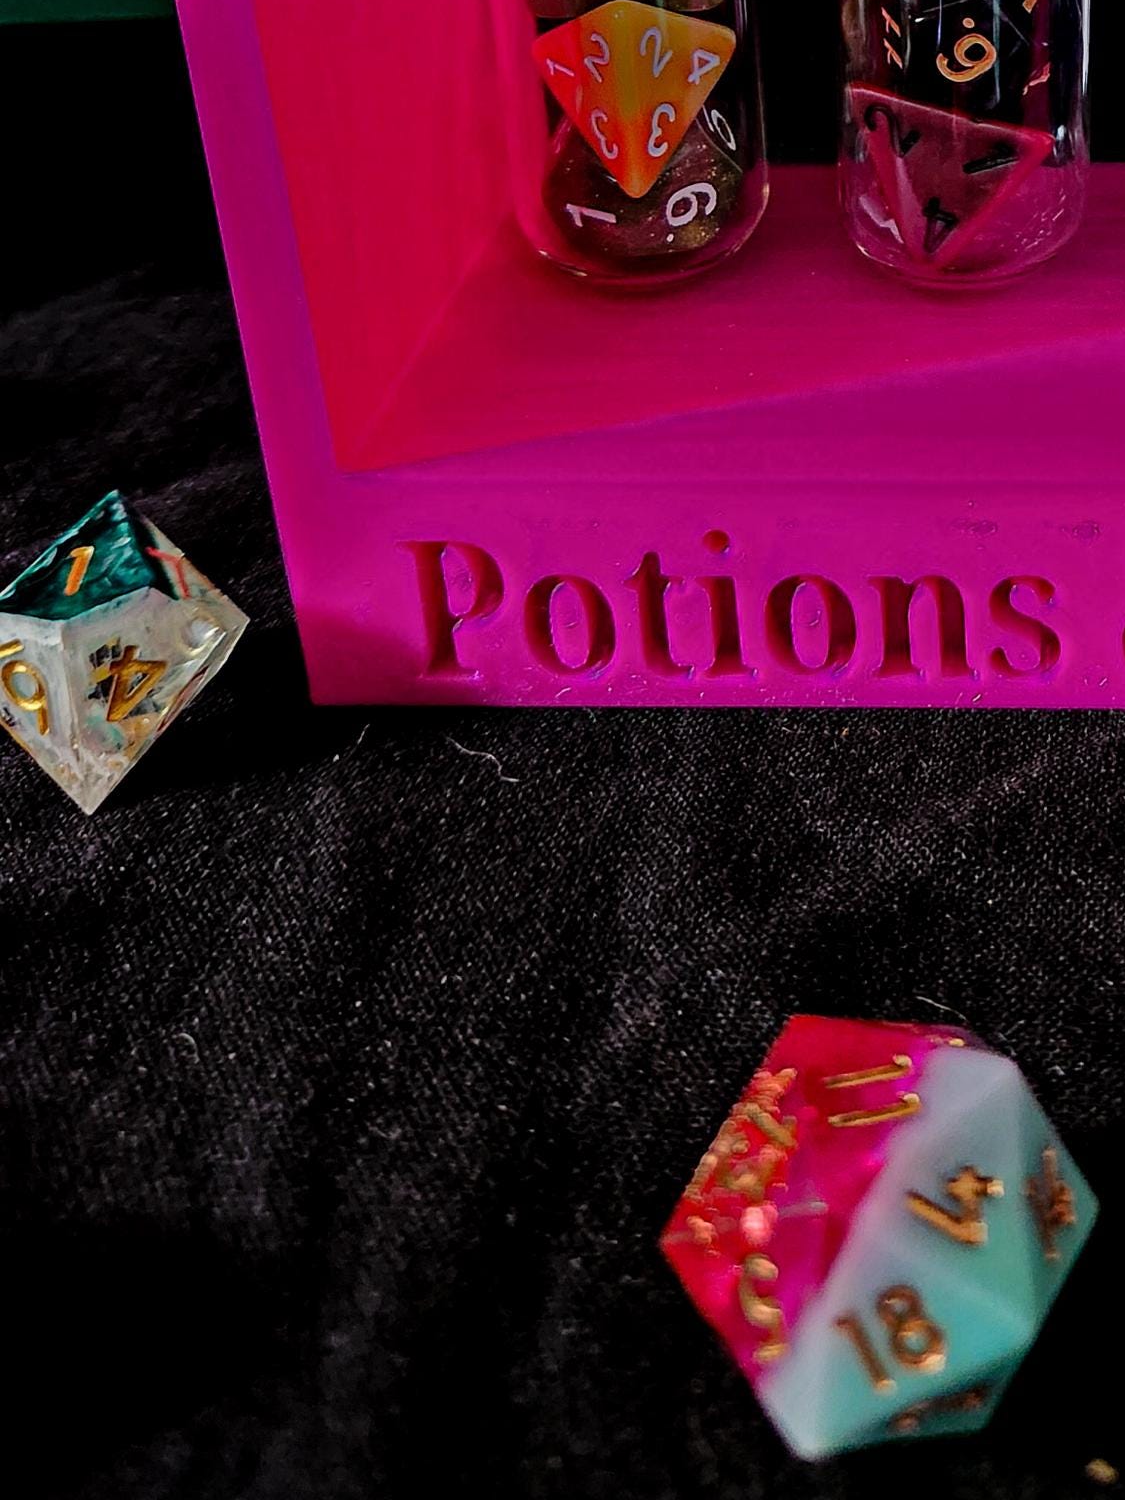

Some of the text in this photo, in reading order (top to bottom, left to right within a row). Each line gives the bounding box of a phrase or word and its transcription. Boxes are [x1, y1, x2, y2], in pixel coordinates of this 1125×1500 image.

[648, 102, 676, 158] 3
[63, 545, 96, 597] 1
[399, 528, 1063, 682] Potions
[832, 1281, 949, 1394] 18
